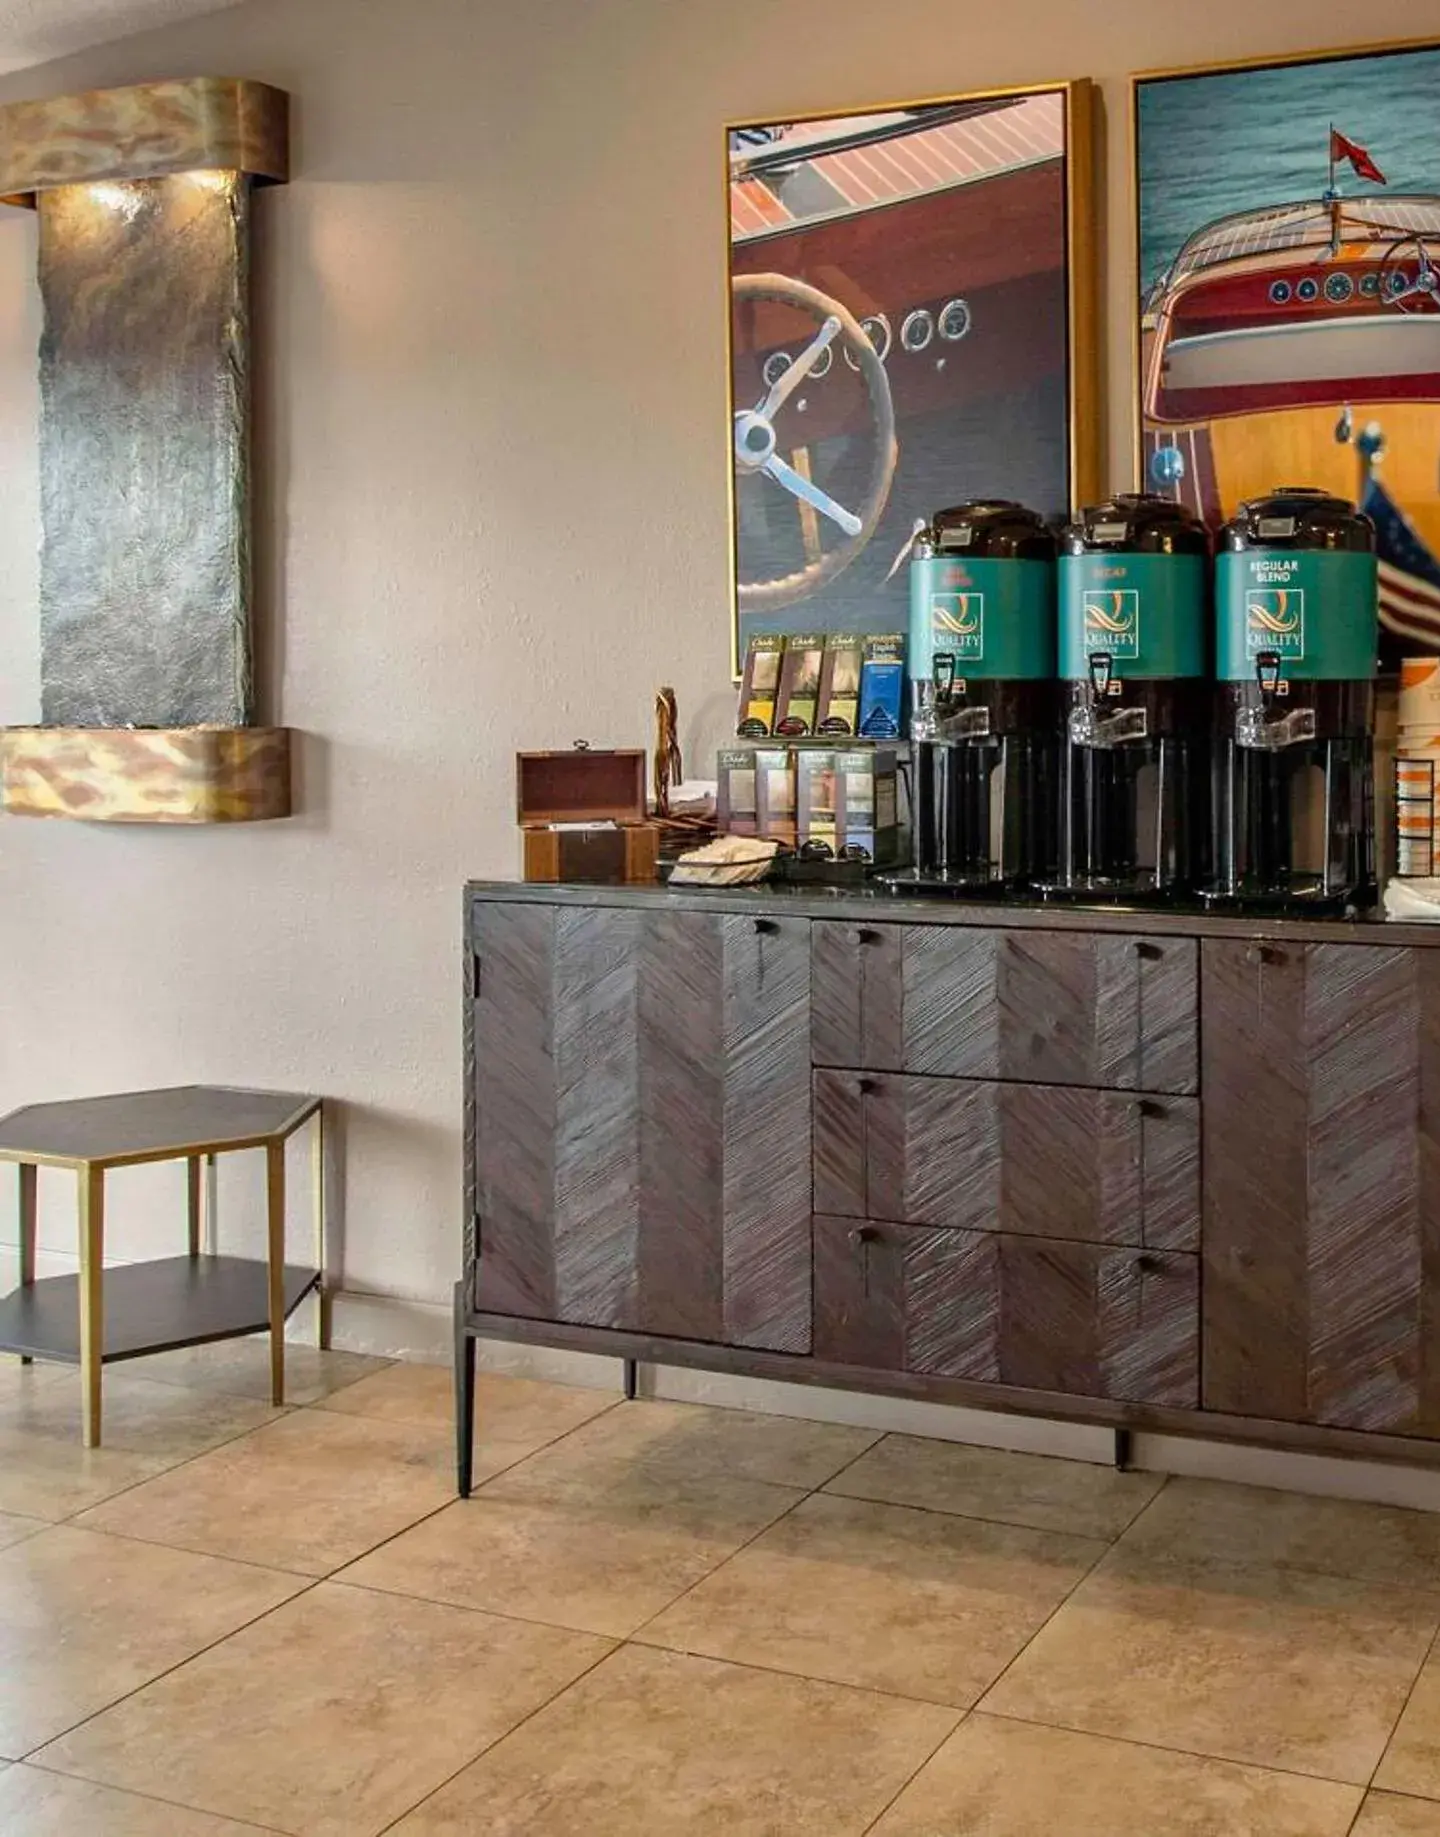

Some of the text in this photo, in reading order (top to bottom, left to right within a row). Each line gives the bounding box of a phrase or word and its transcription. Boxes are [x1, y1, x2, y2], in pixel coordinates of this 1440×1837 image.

[1251, 561, 1298, 572] REGULAR
[1257, 572, 1290, 582] BLEND
[1247, 633, 1300, 647] QUALITY
